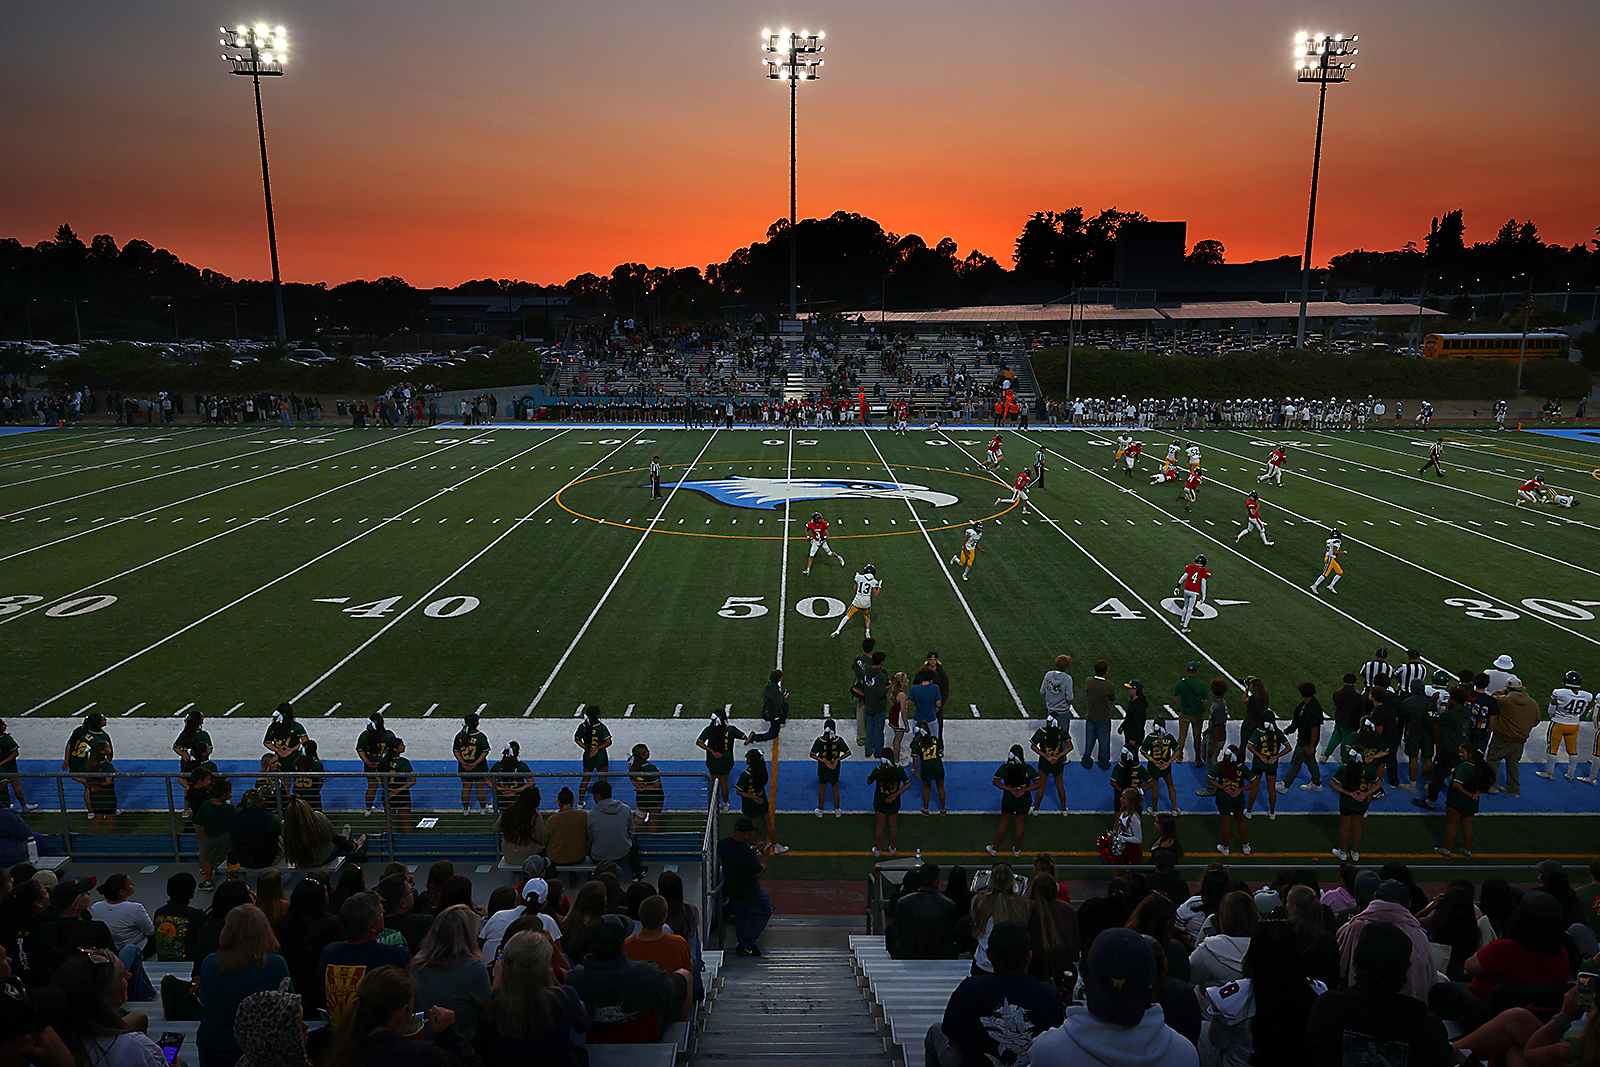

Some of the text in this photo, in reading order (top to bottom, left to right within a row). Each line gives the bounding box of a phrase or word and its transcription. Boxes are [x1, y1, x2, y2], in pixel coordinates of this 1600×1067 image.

[1191, 572, 1199, 584] 4
[858, 582, 871, 594] 13
[342, 596, 480, 618] 40
[717, 597, 847, 618] 50
[1090, 597, 1218, 619] 40
[1443, 597, 1596, 620] 30
[1564, 699, 1587, 716] 48
[461, 746, 476, 760] 27
[922, 745, 937, 760] 27
[1153, 746, 1169, 759] 27
